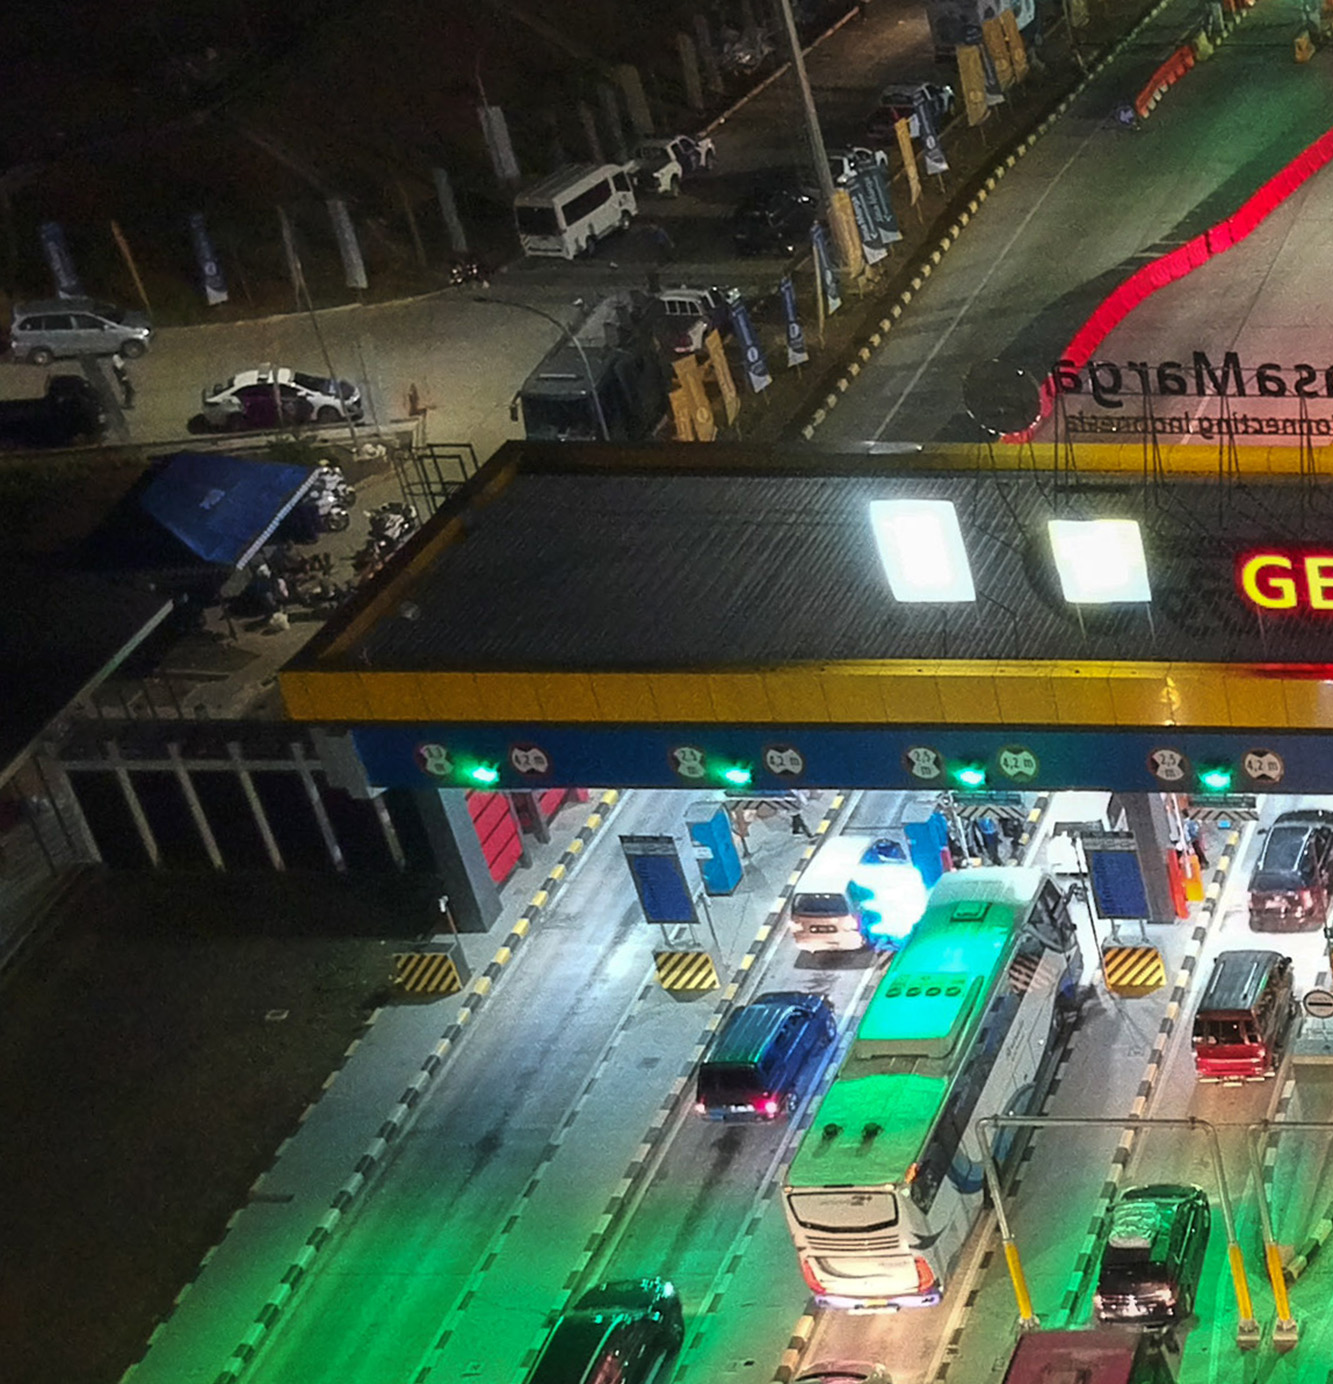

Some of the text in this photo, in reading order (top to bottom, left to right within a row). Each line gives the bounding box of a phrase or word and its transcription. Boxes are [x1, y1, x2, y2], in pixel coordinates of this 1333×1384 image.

[1002, 756, 1033, 770] 4,2 m
[1159, 753, 1176, 766] 2,5
[1247, 759, 1278, 773] 4,2 m
